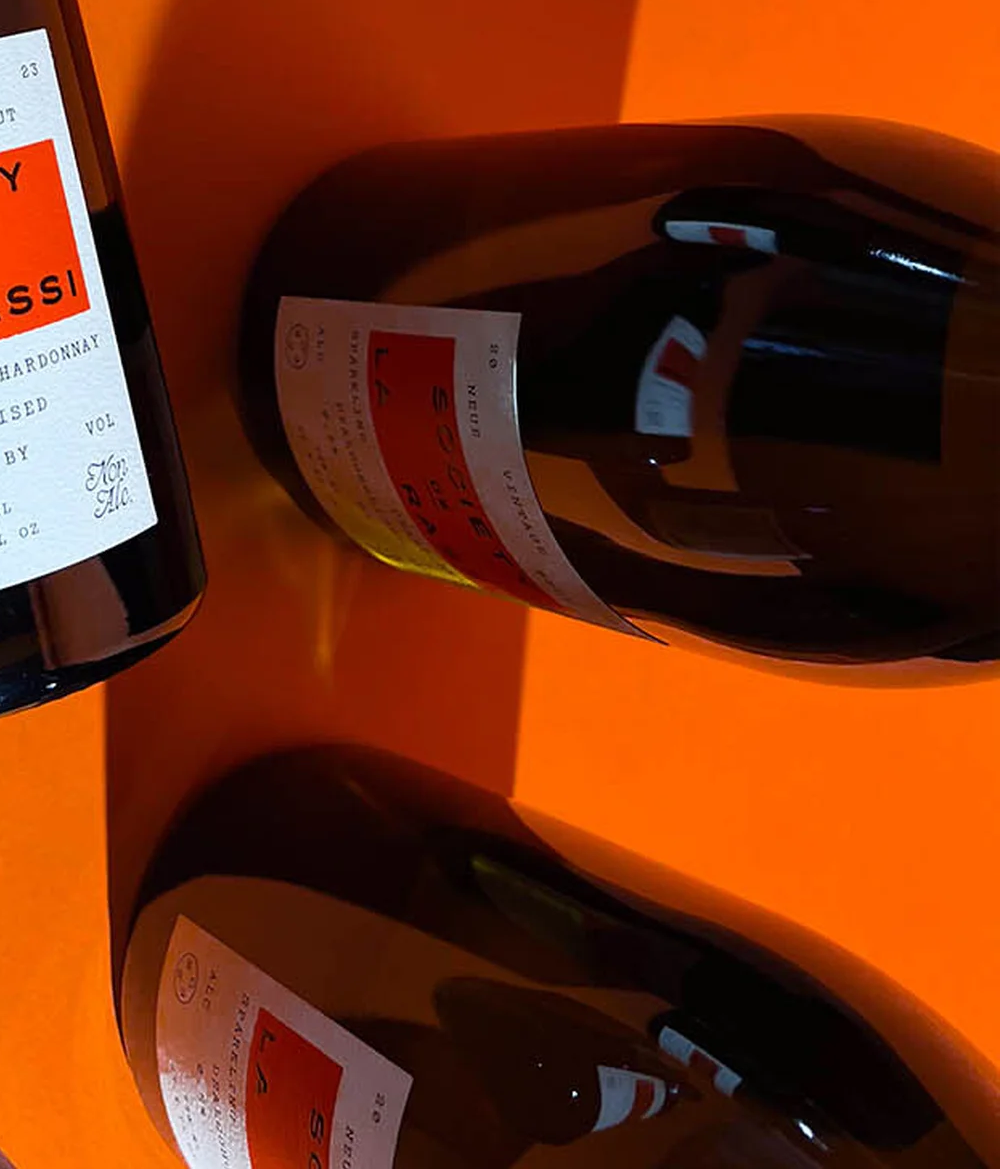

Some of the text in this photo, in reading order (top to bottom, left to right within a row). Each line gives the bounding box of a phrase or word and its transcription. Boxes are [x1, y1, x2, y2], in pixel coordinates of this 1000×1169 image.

[20, 62, 40, 79] 23
[4, 445, 29, 466] BY
[85, 412, 116, 436] VOL
[18, 522, 41, 539] OZ
[256, 1028, 276, 1095] LA
